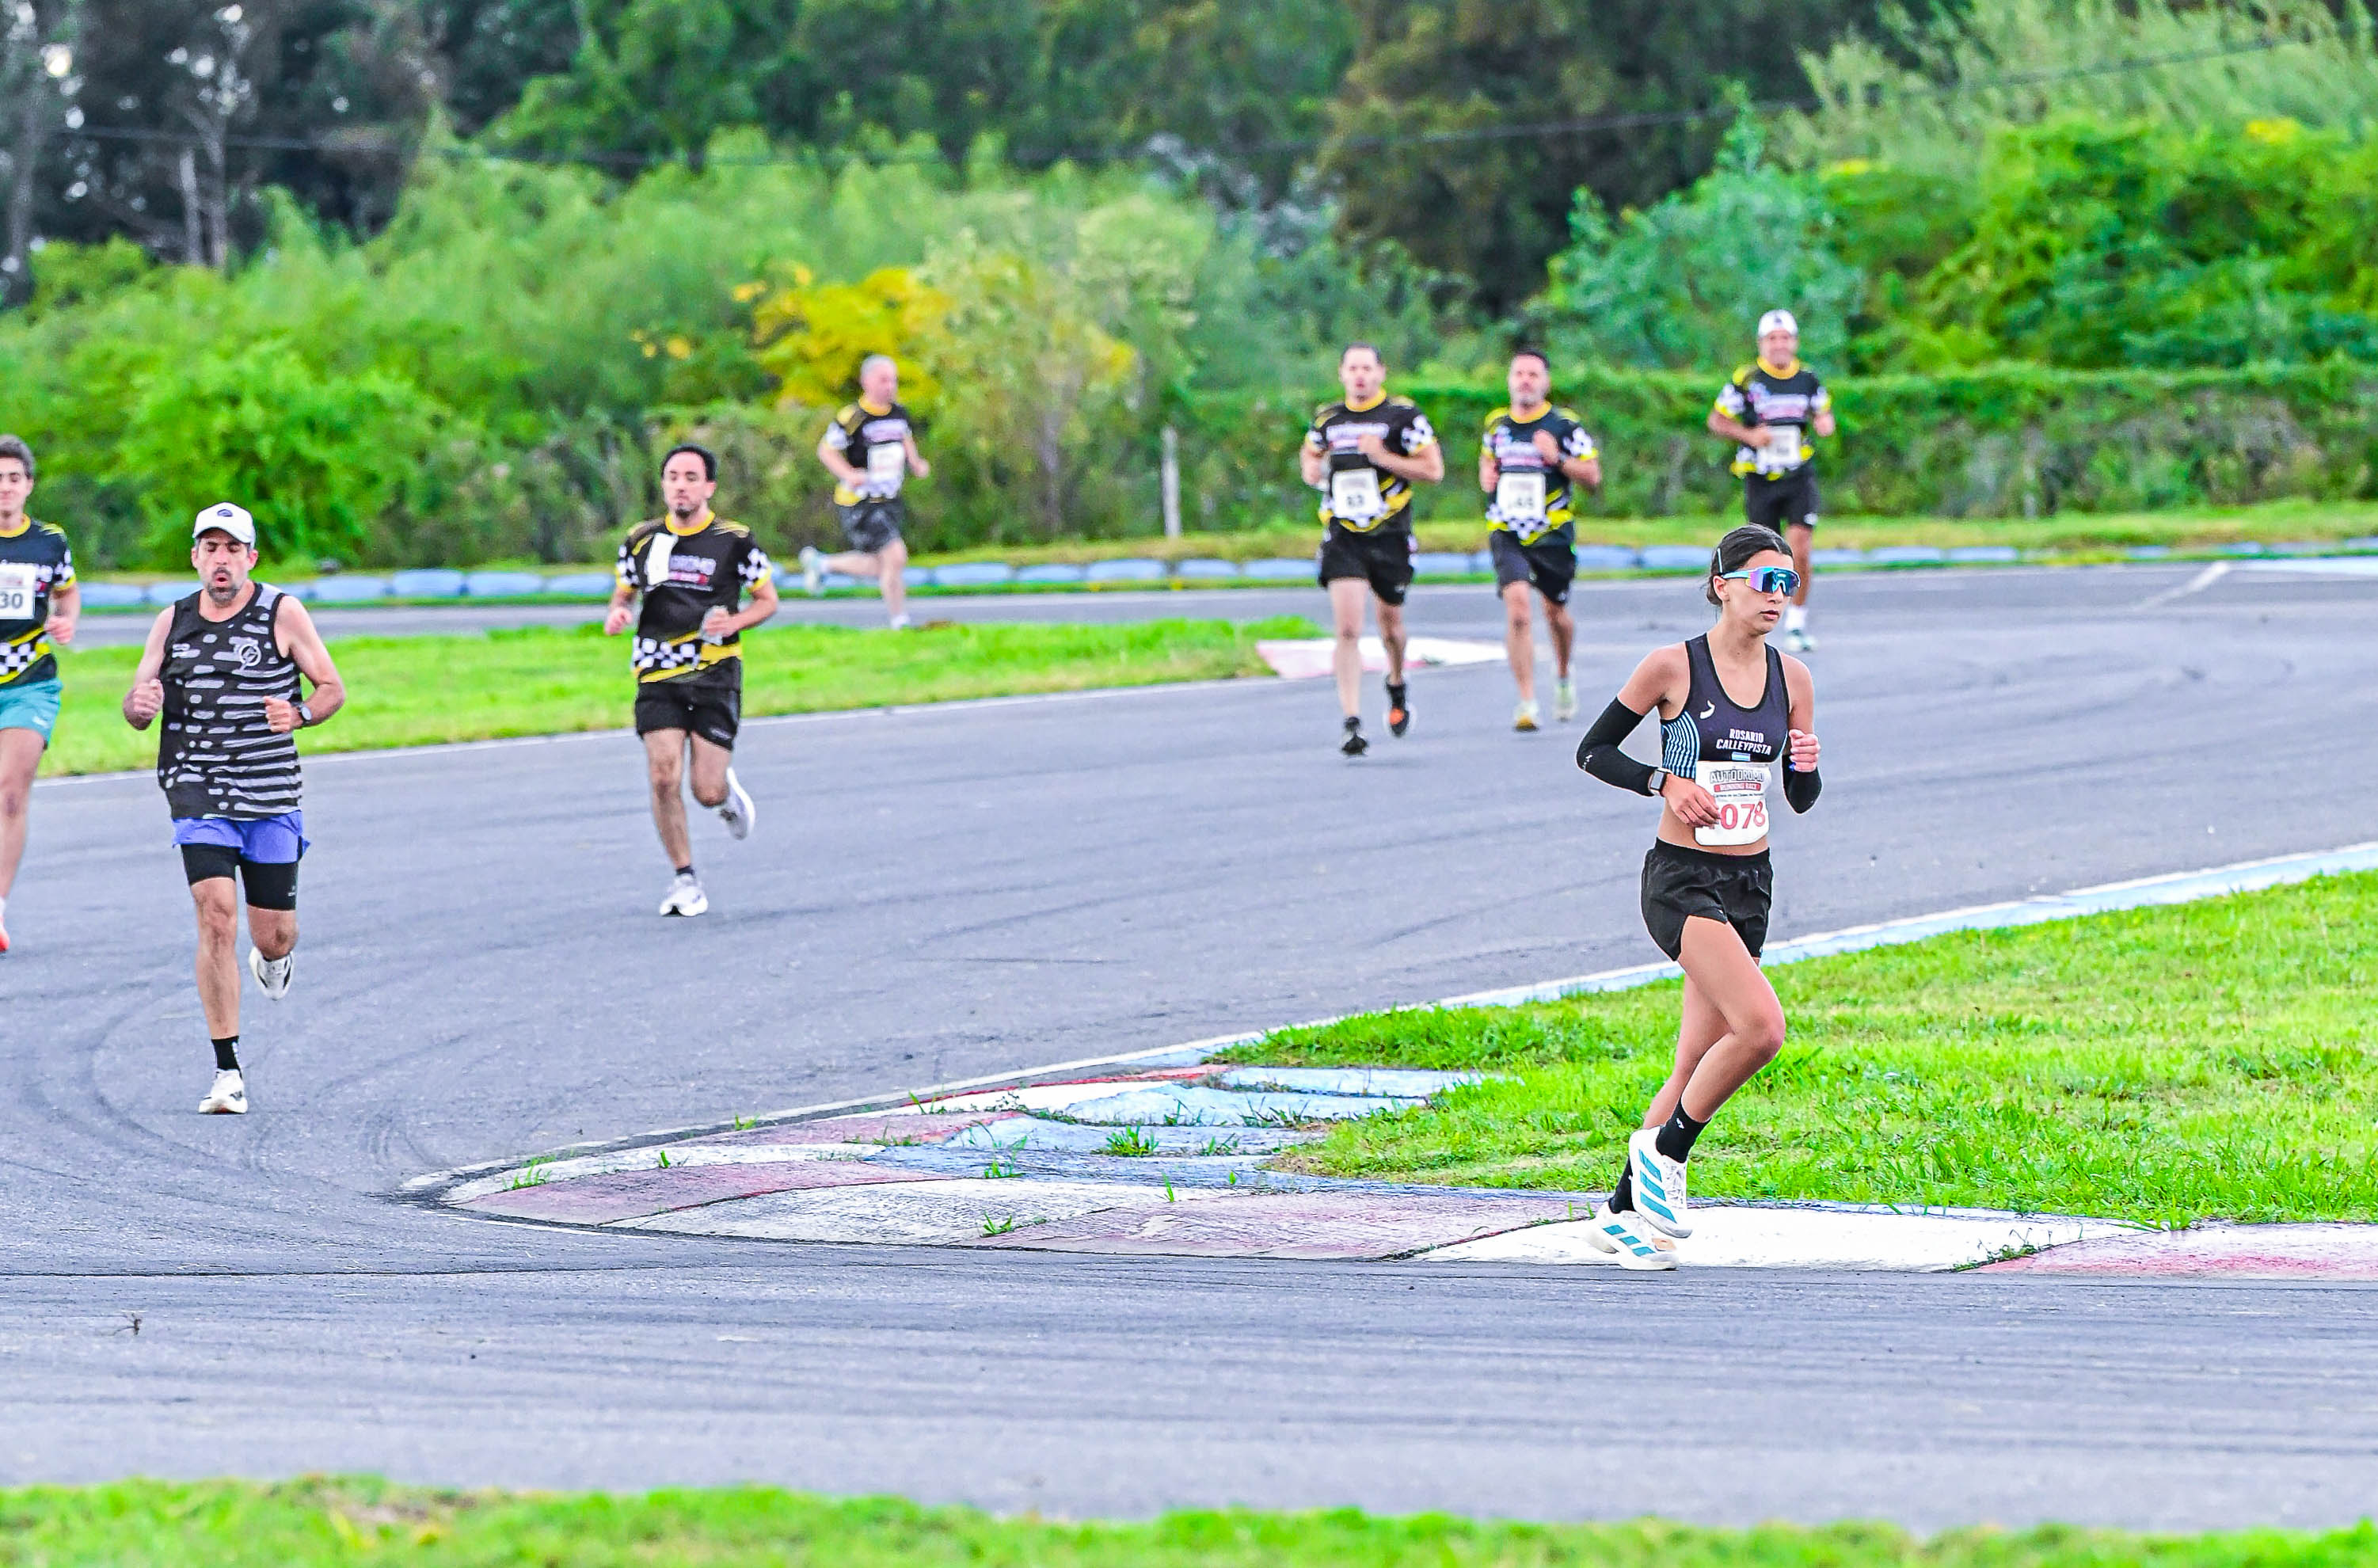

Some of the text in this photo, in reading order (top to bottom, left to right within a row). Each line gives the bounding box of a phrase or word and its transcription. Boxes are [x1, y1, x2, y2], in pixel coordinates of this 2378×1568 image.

[1729, 728, 1764, 743] ROSARIO
[1715, 738, 1772, 755] CALLEYPISTA
[1709, 801, 1766, 830] 078
